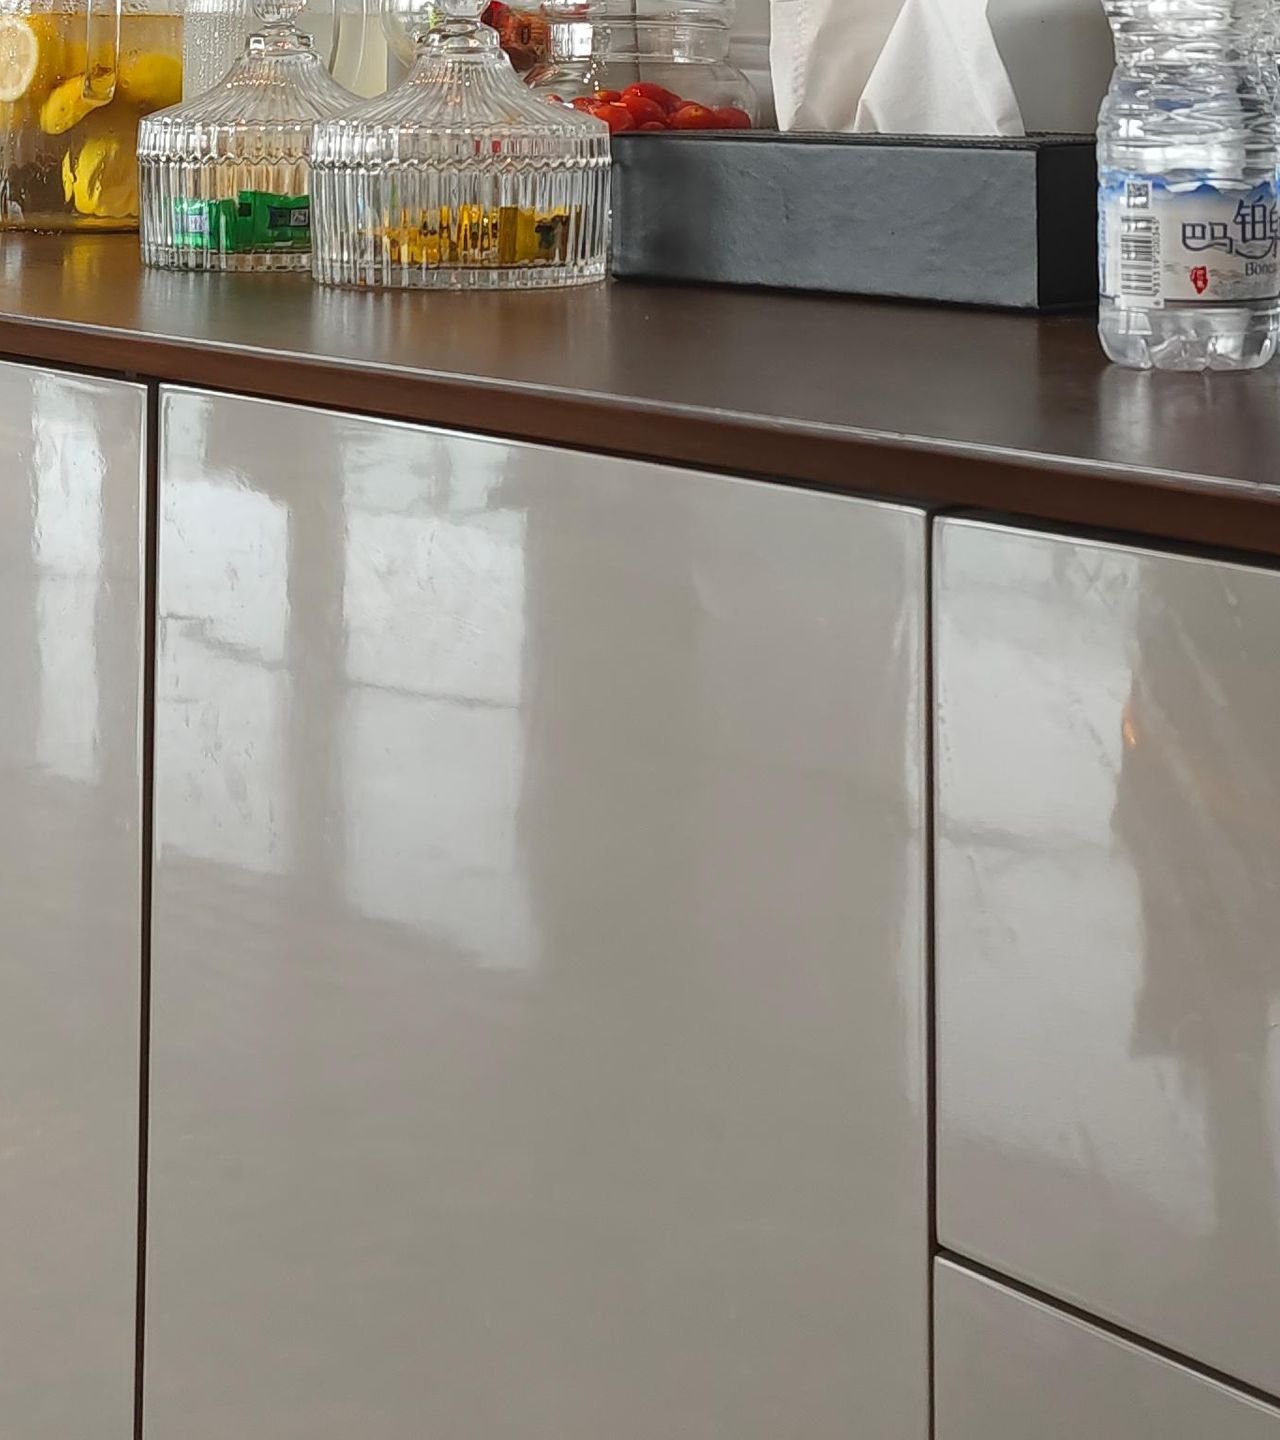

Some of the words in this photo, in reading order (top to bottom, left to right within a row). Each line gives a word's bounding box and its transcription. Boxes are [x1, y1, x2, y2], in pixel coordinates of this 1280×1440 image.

[1182, 195, 1277, 259] 巴马铂
[1245, 262, 1276, 276] Bone
